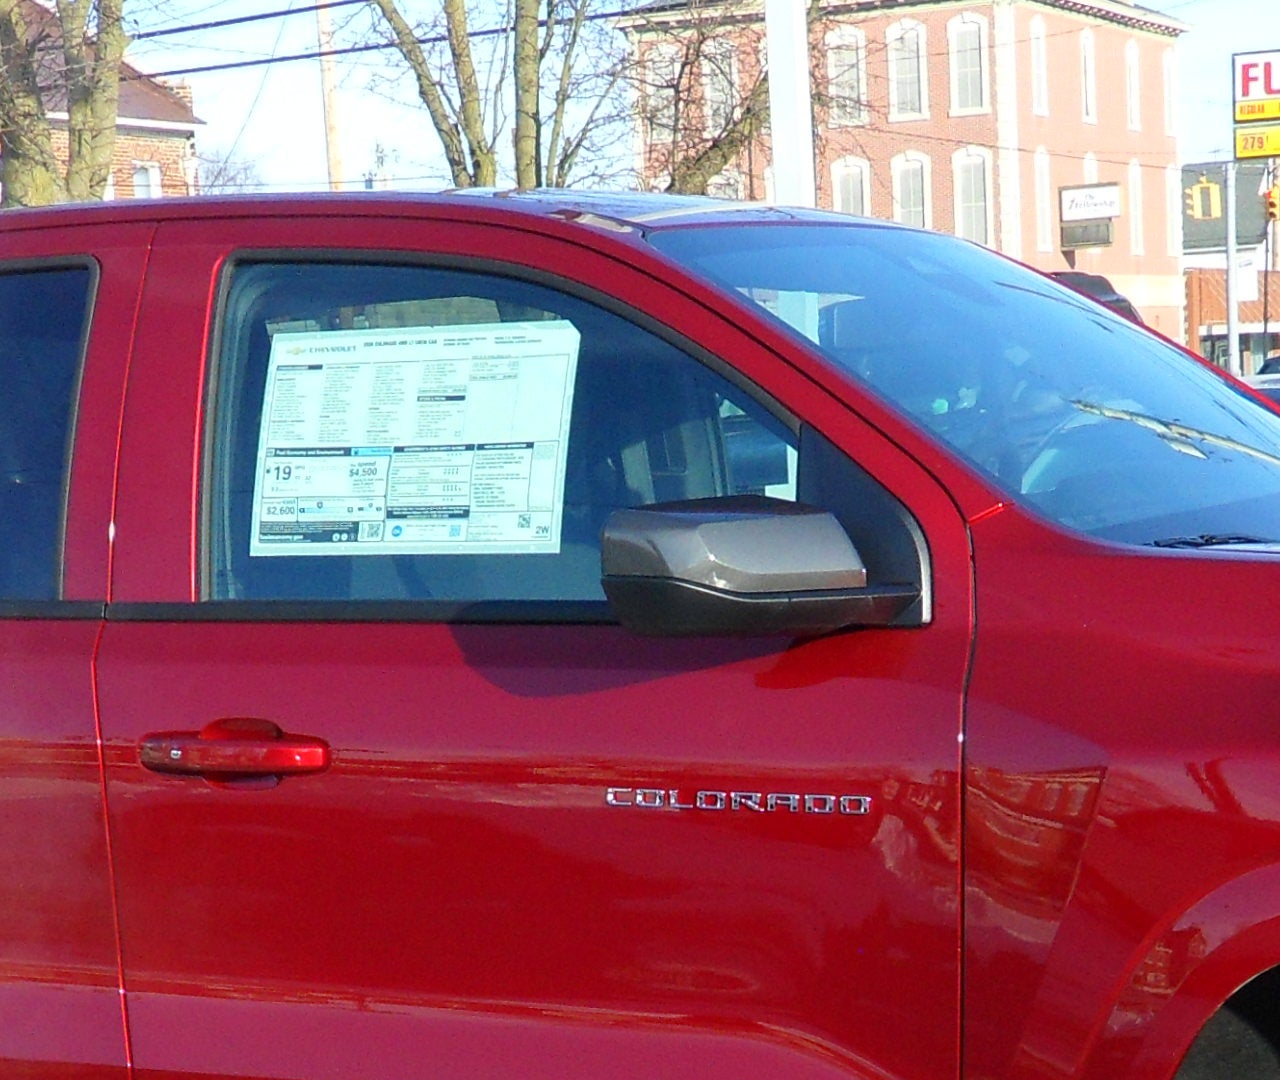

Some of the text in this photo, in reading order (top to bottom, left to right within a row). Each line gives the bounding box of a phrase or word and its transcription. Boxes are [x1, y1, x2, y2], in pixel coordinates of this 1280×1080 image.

[1242, 136, 1265, 151] 279
[274, 465, 292, 481] 19
[605, 787, 871, 815] COLORADO
